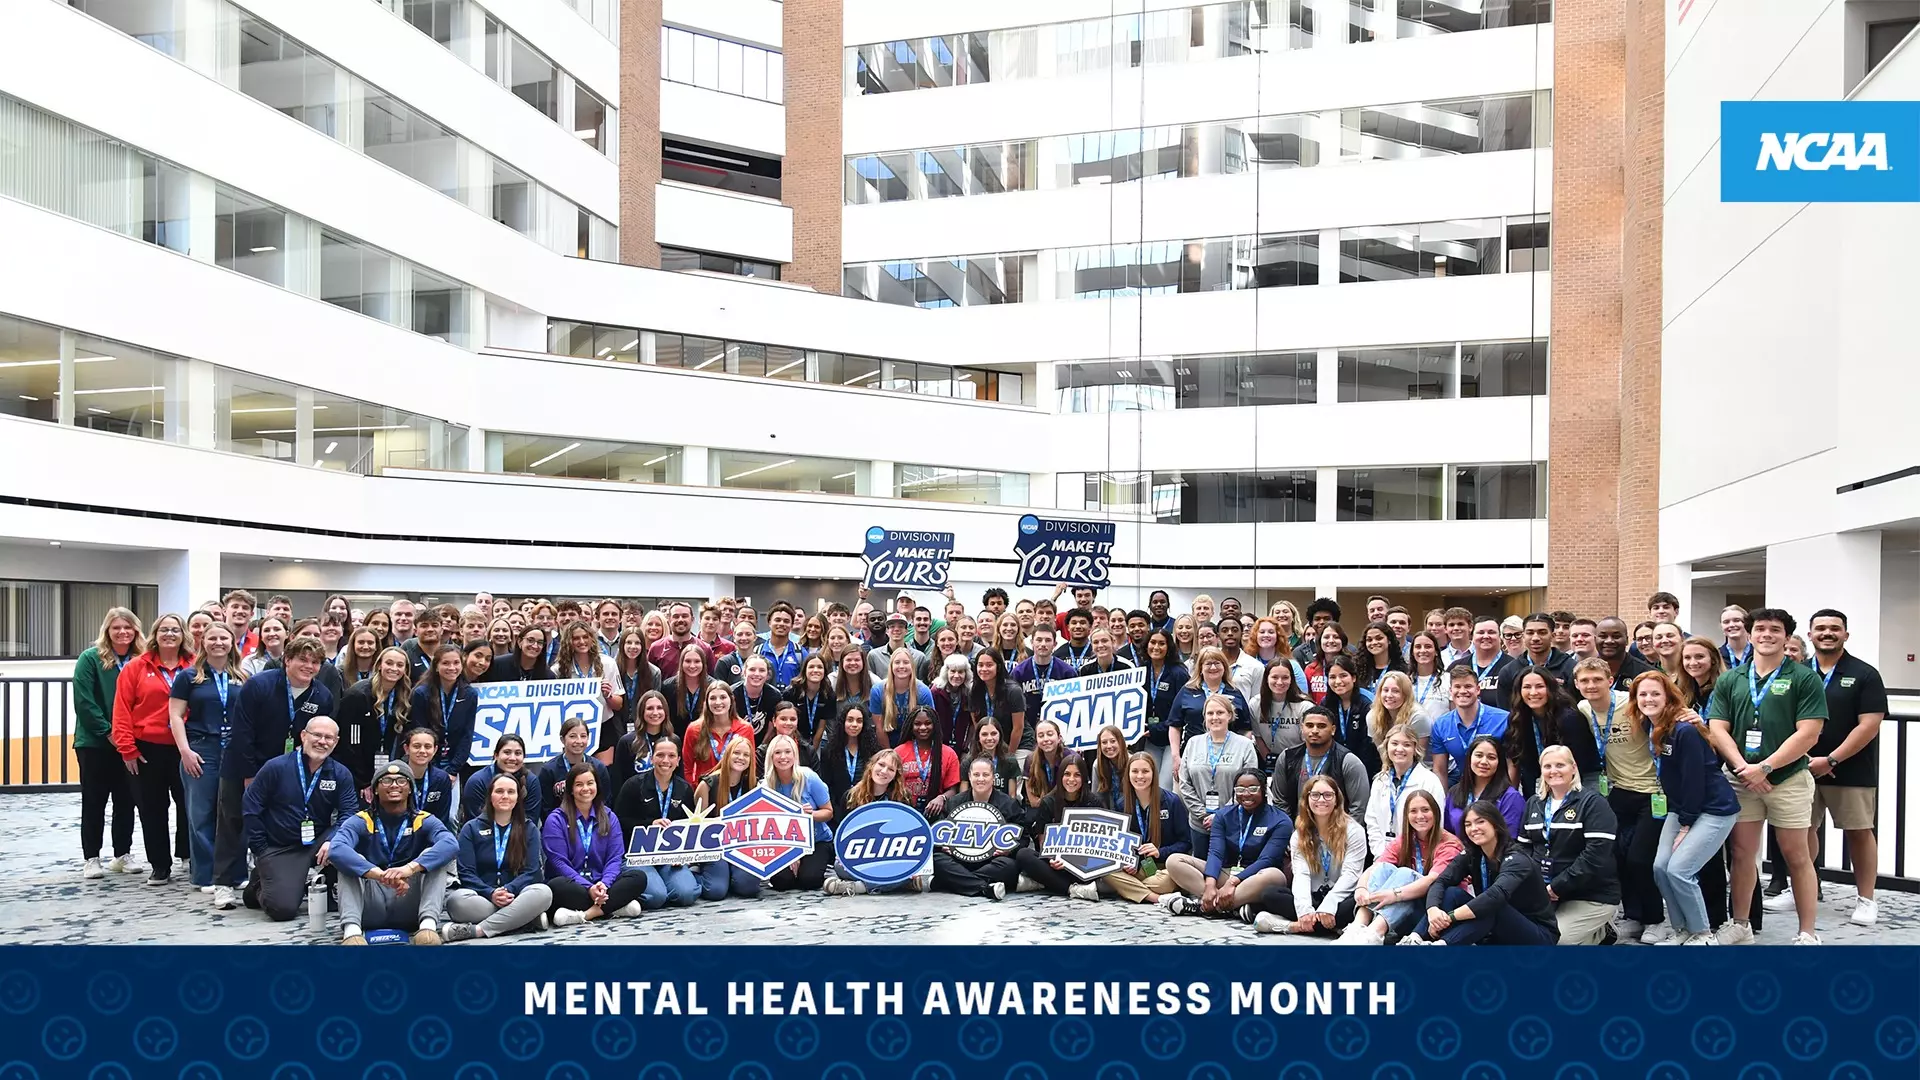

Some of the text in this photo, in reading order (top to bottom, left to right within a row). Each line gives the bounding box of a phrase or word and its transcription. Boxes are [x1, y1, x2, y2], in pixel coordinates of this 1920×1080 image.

[890, 531, 940, 542] DIVISION
[944, 533, 950, 542] II
[1045, 521, 1100, 533] DIVISION
[1104, 524, 1111, 534] II
[895, 547, 952, 560] MAKE IT
[1051, 539, 1112, 554] MAKE IT
[861, 549, 950, 590] YOURS
[1014, 542, 1110, 586] YOURS
[476, 681, 597, 700] NCAA DIVISION II
[1046, 670, 1143, 697] NCAA DIVISION II
[1043, 688, 1143, 748] SAAC
[471, 700, 598, 761] SAAC
[950, 804, 967, 818] GREAT
[986, 804, 1003, 820] VALLEY
[722, 817, 806, 846] MIAA
[931, 820, 1021, 850] GLVC
[1071, 821, 1117, 837] GREAT
[629, 823, 725, 855] NSIC
[843, 835, 928, 860] GLIAC
[628, 853, 720, 866] Northern Sun Intercollegiate Conference
[751, 847, 776, 858] 1912
[953, 849, 990, 861] CONFERENCE
[1044, 846, 1135, 865] ATHLETIC CONFERENCE
